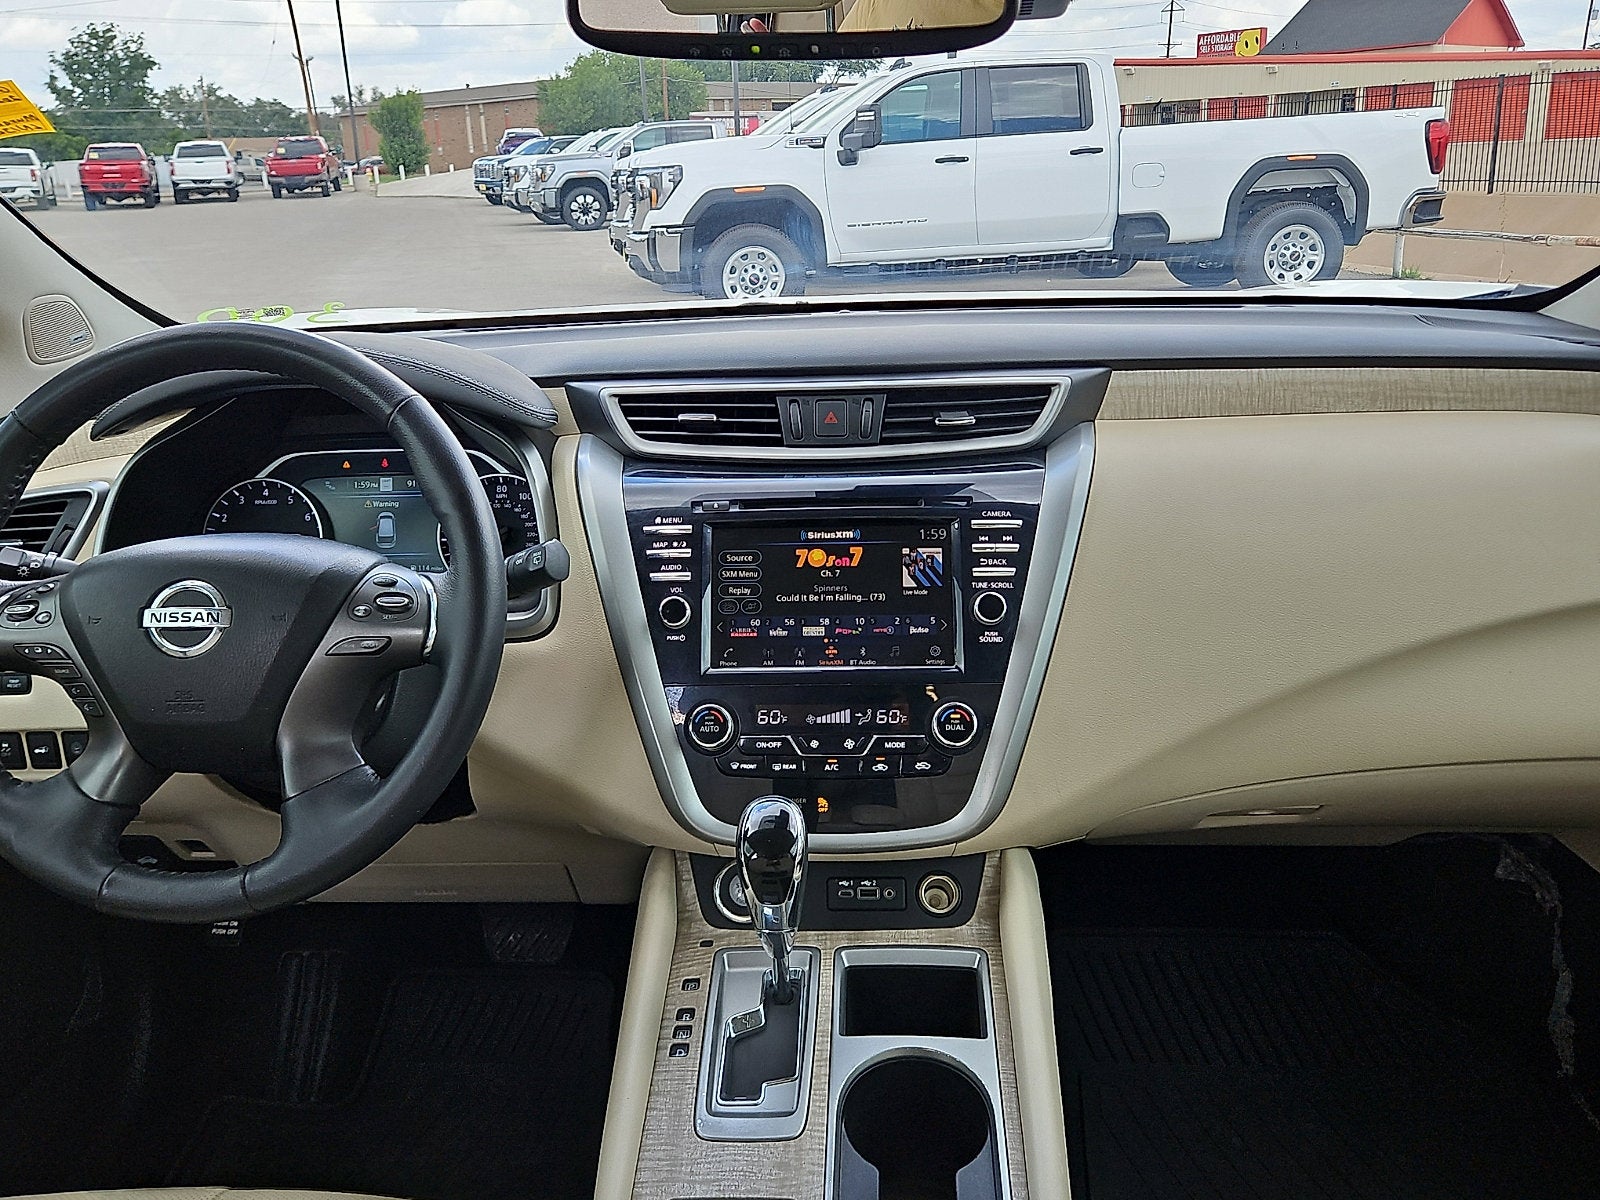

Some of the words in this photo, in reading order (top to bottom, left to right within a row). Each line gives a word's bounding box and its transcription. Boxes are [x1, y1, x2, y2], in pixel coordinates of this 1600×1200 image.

[1199, 33, 1240, 45] AFFORDABLE
[1200, 43, 1211, 53] SELF
[1212, 42, 1233, 53] STORAGE
[406, 480, 416, 488] 91
[262, 488, 269, 496] 4
[496, 485, 508, 493] 80
[238, 496, 245, 505] 3
[287, 496, 294, 505] 5
[372, 500, 400, 509] Warning
[221, 514, 228, 522] 2
[304, 513, 311, 522] 6
[919, 528, 947, 540] 1:59
[726, 554, 754, 562] Source
[988, 558, 1008, 566] BACK
[721, 570, 738, 578] SXM
[738, 570, 758, 578] Menu
[820, 569, 834, 578] Ch.
[835, 569, 841, 578] 7
[728, 586, 752, 596] Replay
[813, 584, 848, 594] Spinners
[913, 588, 928, 596] Mode
[775, 593, 800, 602] Could
[800, 593, 808, 602] It
[808, 593, 820, 602] Be
[820, 593, 834, 602] I'm
[869, 592, 886, 602] (73)
[149, 611, 221, 624] NISSAN
[819, 617, 830, 626] 58
[855, 617, 866, 625] 10
[894, 616, 901, 625] 2
[930, 616, 937, 624] 5
[750, 618, 761, 626] 60
[784, 618, 795, 626] 56
[699, 725, 720, 733] AUTO
[884, 741, 906, 749] MODE
